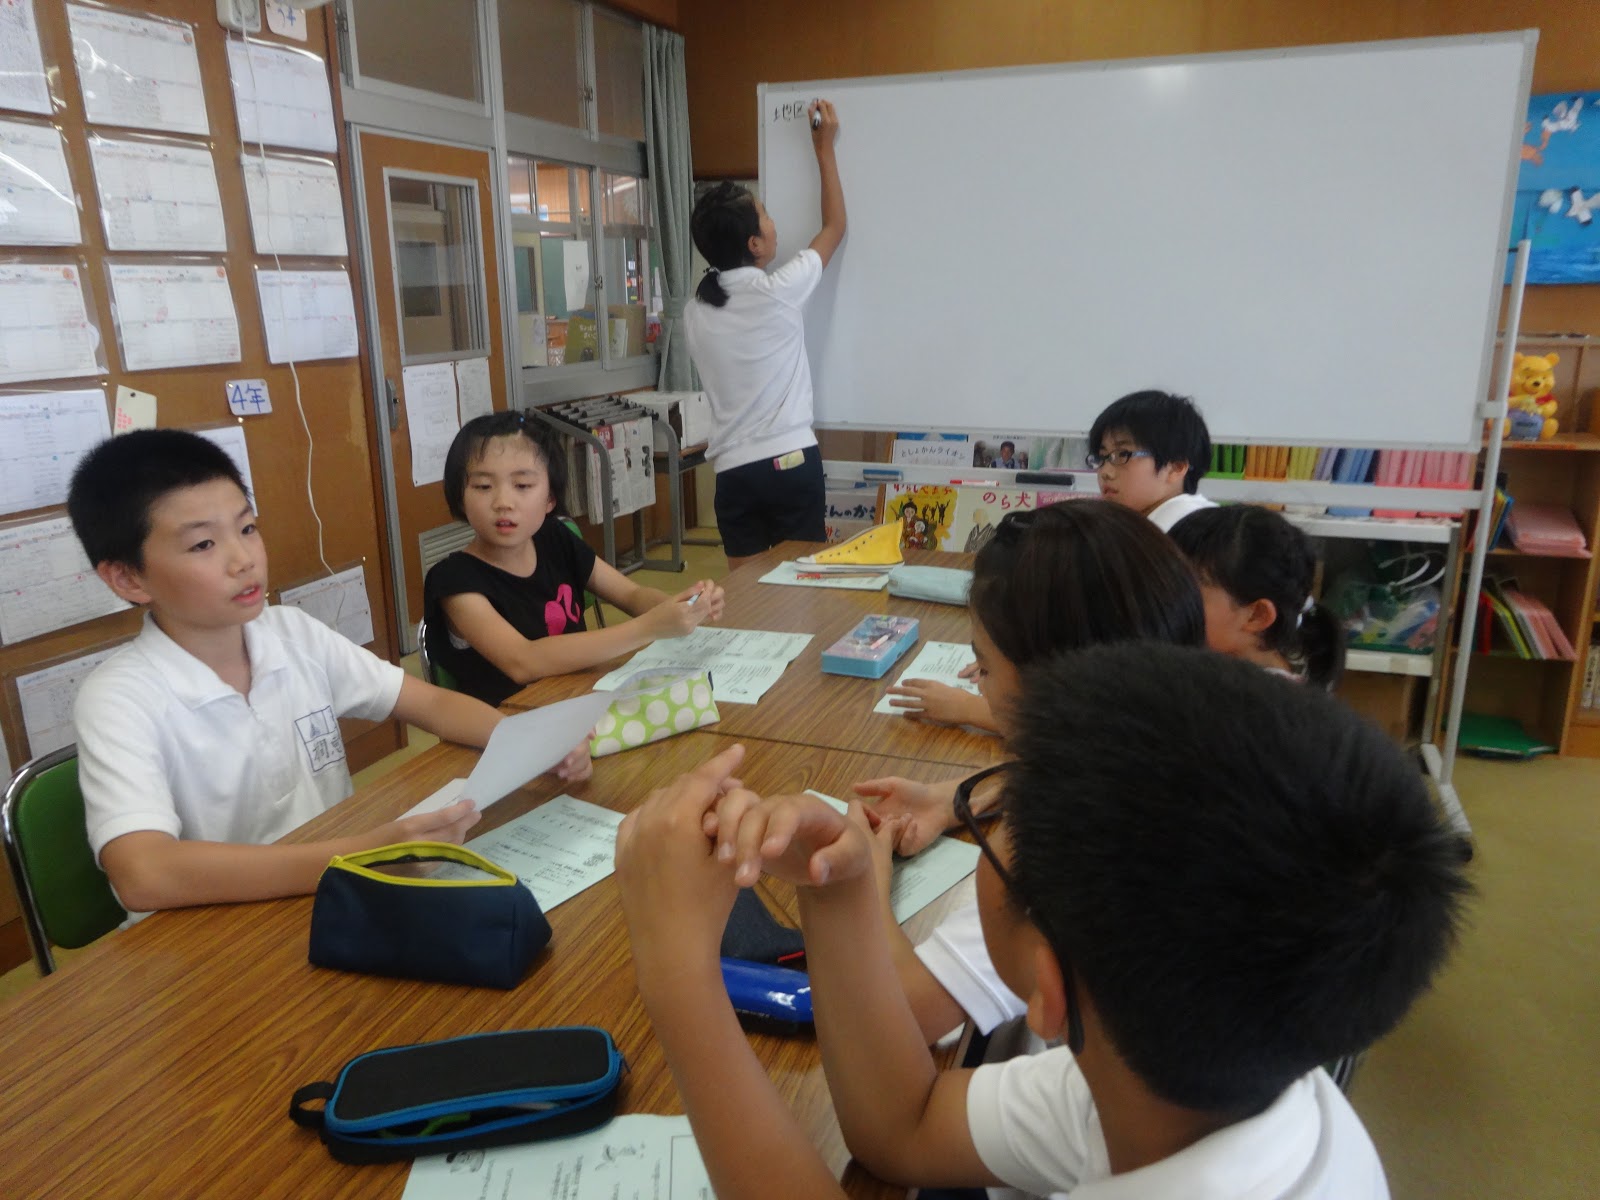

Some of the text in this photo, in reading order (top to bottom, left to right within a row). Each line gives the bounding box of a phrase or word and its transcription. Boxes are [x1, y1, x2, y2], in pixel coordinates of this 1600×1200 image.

[231, 382, 266, 413] 4年
[901, 445, 966, 460] としょかんライオン
[982, 490, 1031, 510] のら犬
